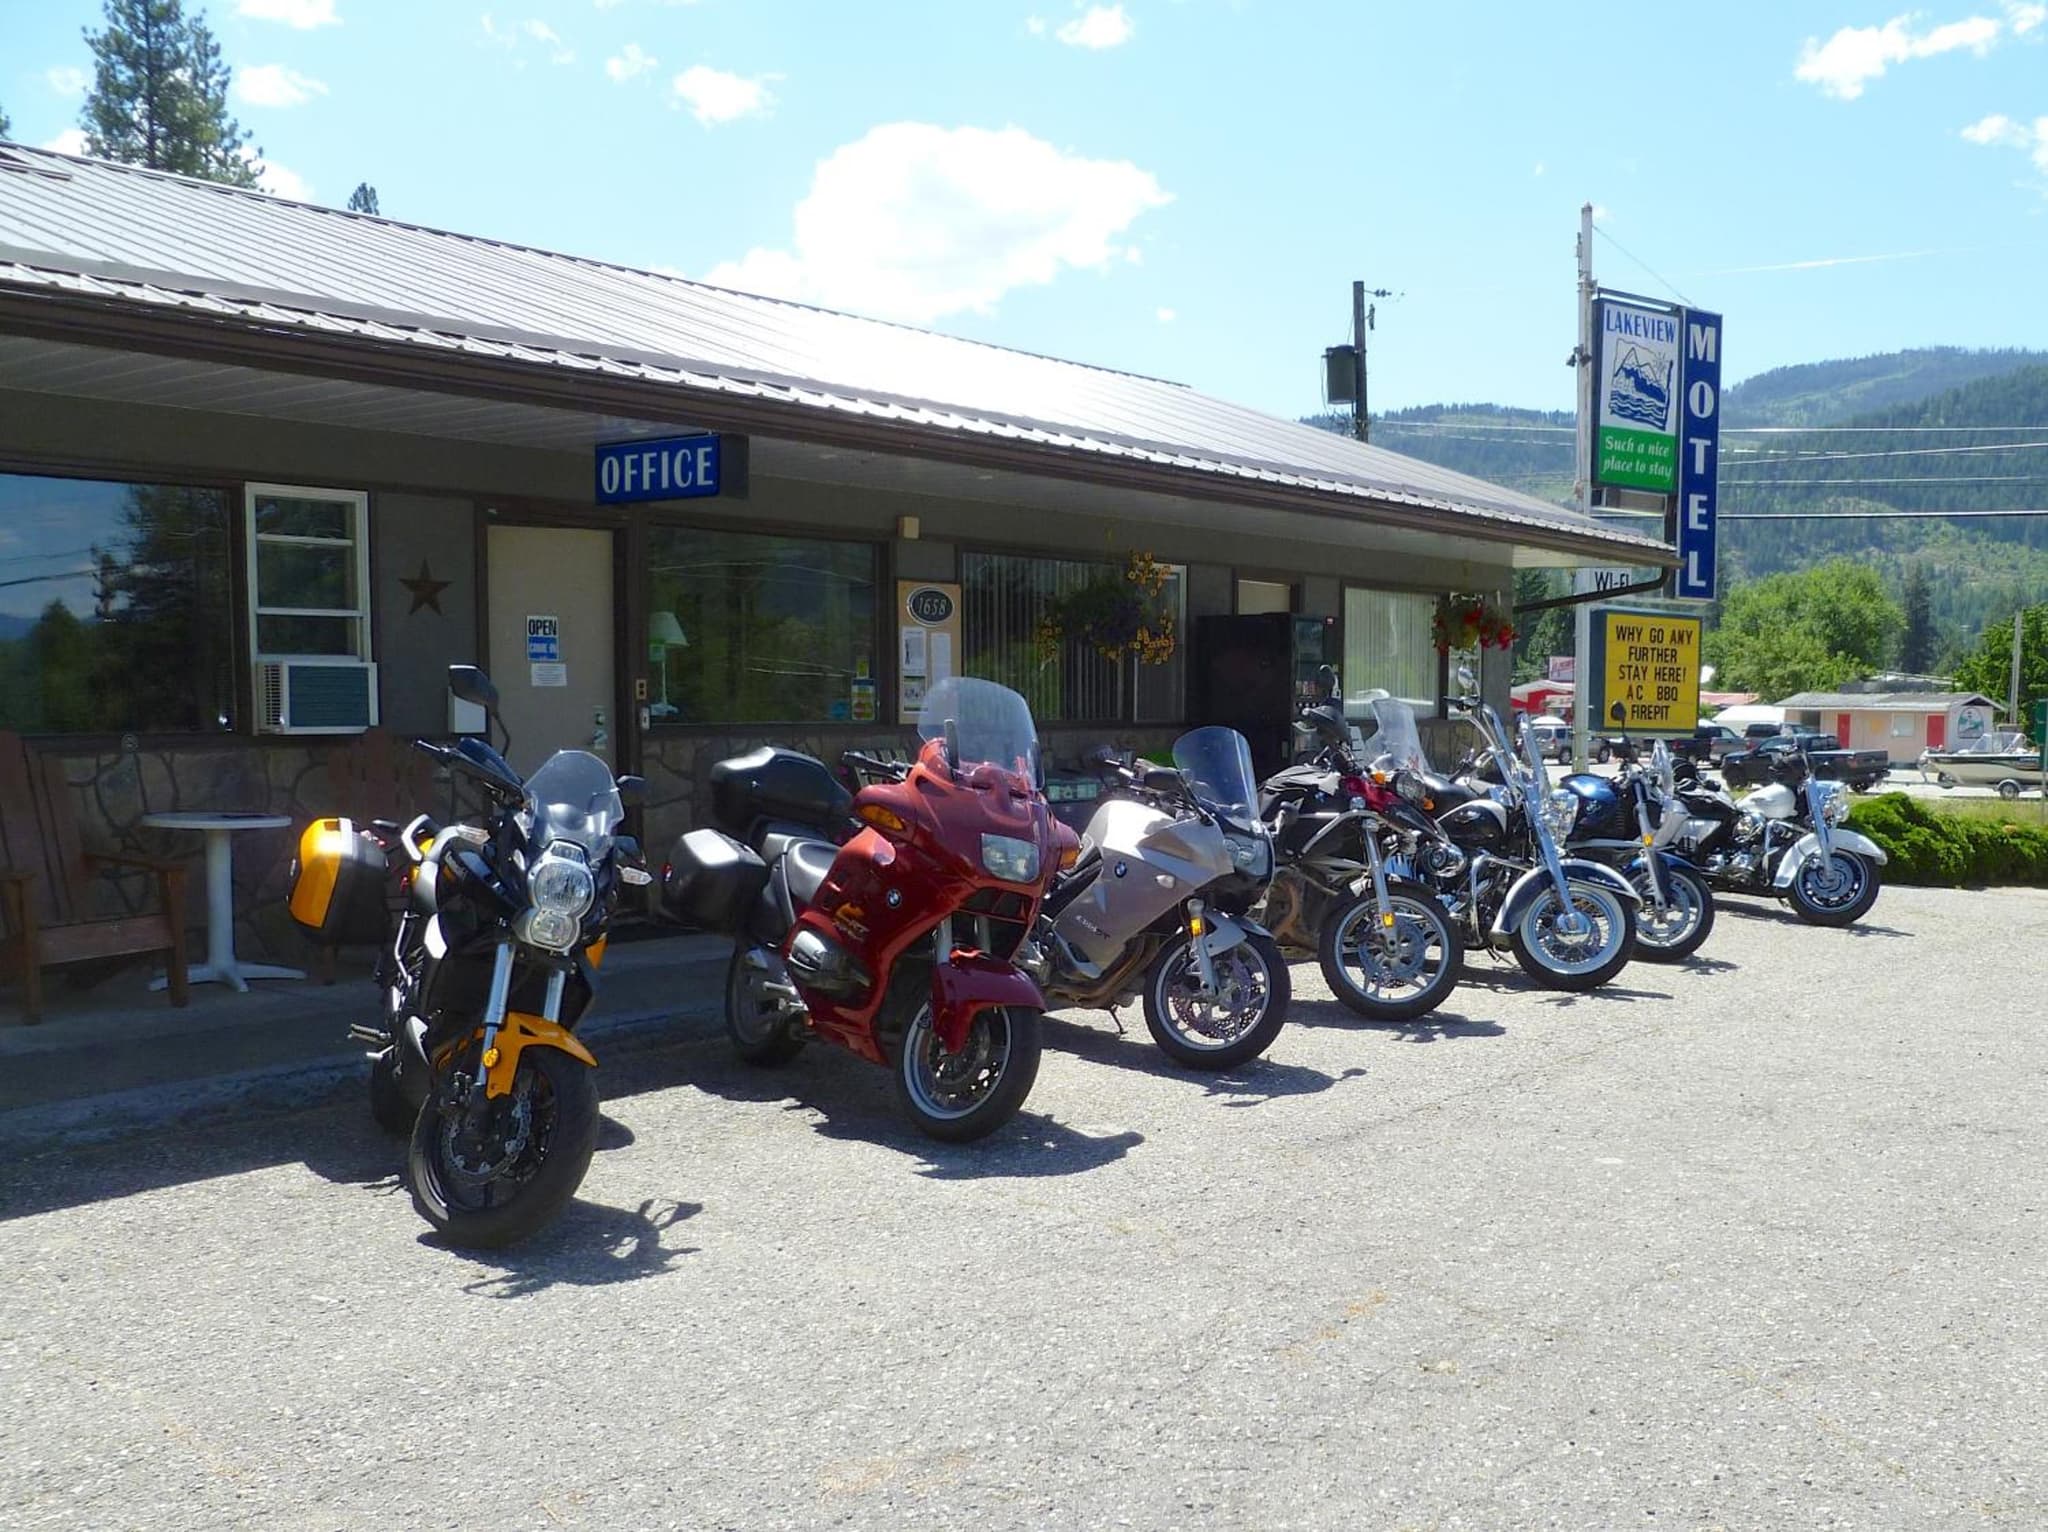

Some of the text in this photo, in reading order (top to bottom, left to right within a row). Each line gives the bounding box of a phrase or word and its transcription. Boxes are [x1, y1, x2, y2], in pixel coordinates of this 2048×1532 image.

[1606, 309, 1676, 344] LAKEVIEW
[1605, 435, 1669, 458] Such a nice
[1688, 323, 1716, 588] MOTEL
[601, 446, 714, 494] OFFICE
[1600, 455, 1672, 481] place to stay
[918, 597, 946, 616] 1658
[528, 619, 557, 636] OPEN
[1616, 625, 1693, 645] WHY GO ANY
[1628, 646, 1678, 663] FURTHER
[1618, 664, 1686, 683] STAY HERE!
[1657, 686, 1678, 702] BBQ
[1631, 704, 1671, 721] FIREPIT
